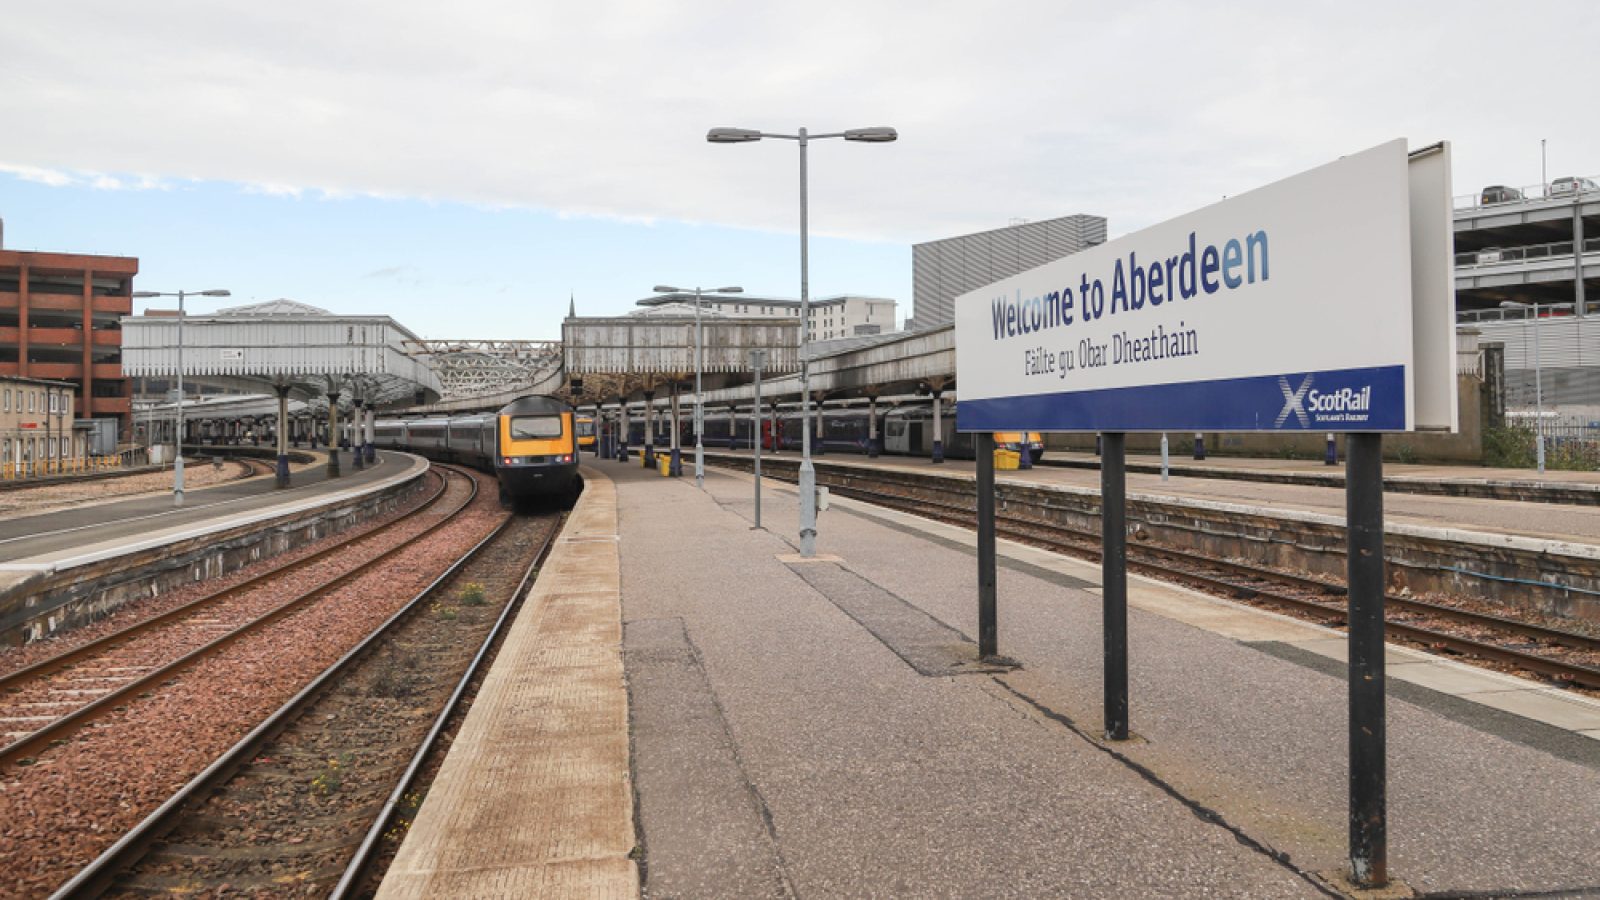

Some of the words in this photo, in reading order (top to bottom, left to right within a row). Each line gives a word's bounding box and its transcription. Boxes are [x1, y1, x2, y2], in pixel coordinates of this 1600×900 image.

[991, 287, 1074, 341] Welcome
[1079, 272, 1104, 322] to
[1110, 230, 1270, 315] Aberdeen
[1059, 350, 1075, 379] gu
[1079, 337, 1108, 369] Obar
[1112, 320, 1199, 365] Dheathain
[1308, 385, 1370, 411] ScotRail
